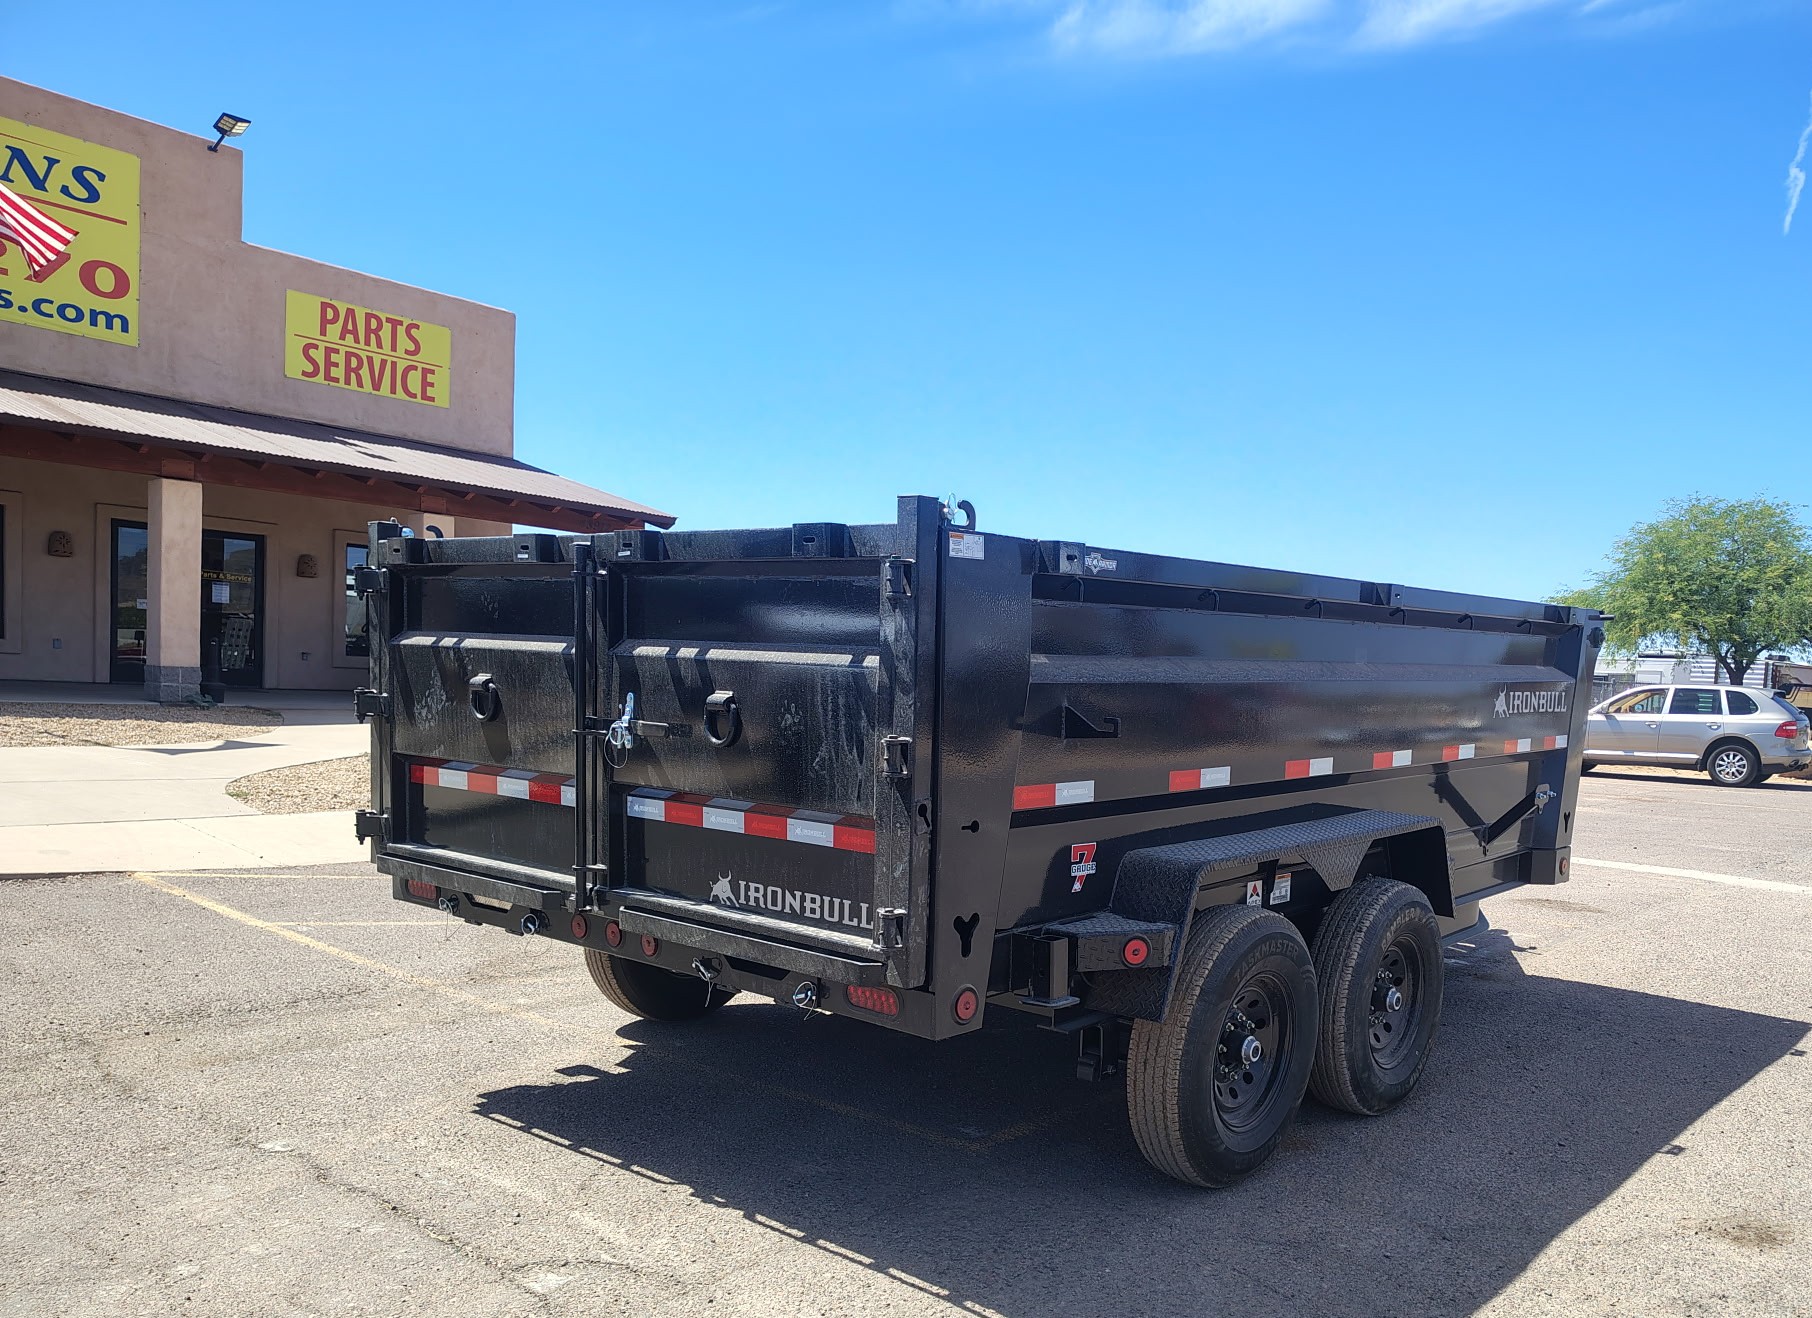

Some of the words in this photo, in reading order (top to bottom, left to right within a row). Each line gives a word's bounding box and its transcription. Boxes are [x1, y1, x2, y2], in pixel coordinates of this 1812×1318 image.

[0, 144, 107, 204] NS
[319, 300, 422, 357] PARTS
[300, 342, 436, 403] SERVICE
[226, 574, 251, 582] Service
[1508, 692, 1567, 713] IRONBULL
[1072, 863, 1096, 873] GAUGE
[738, 880, 874, 930] IRONBULL
[1233, 940, 1299, 983] TASKMASTER
